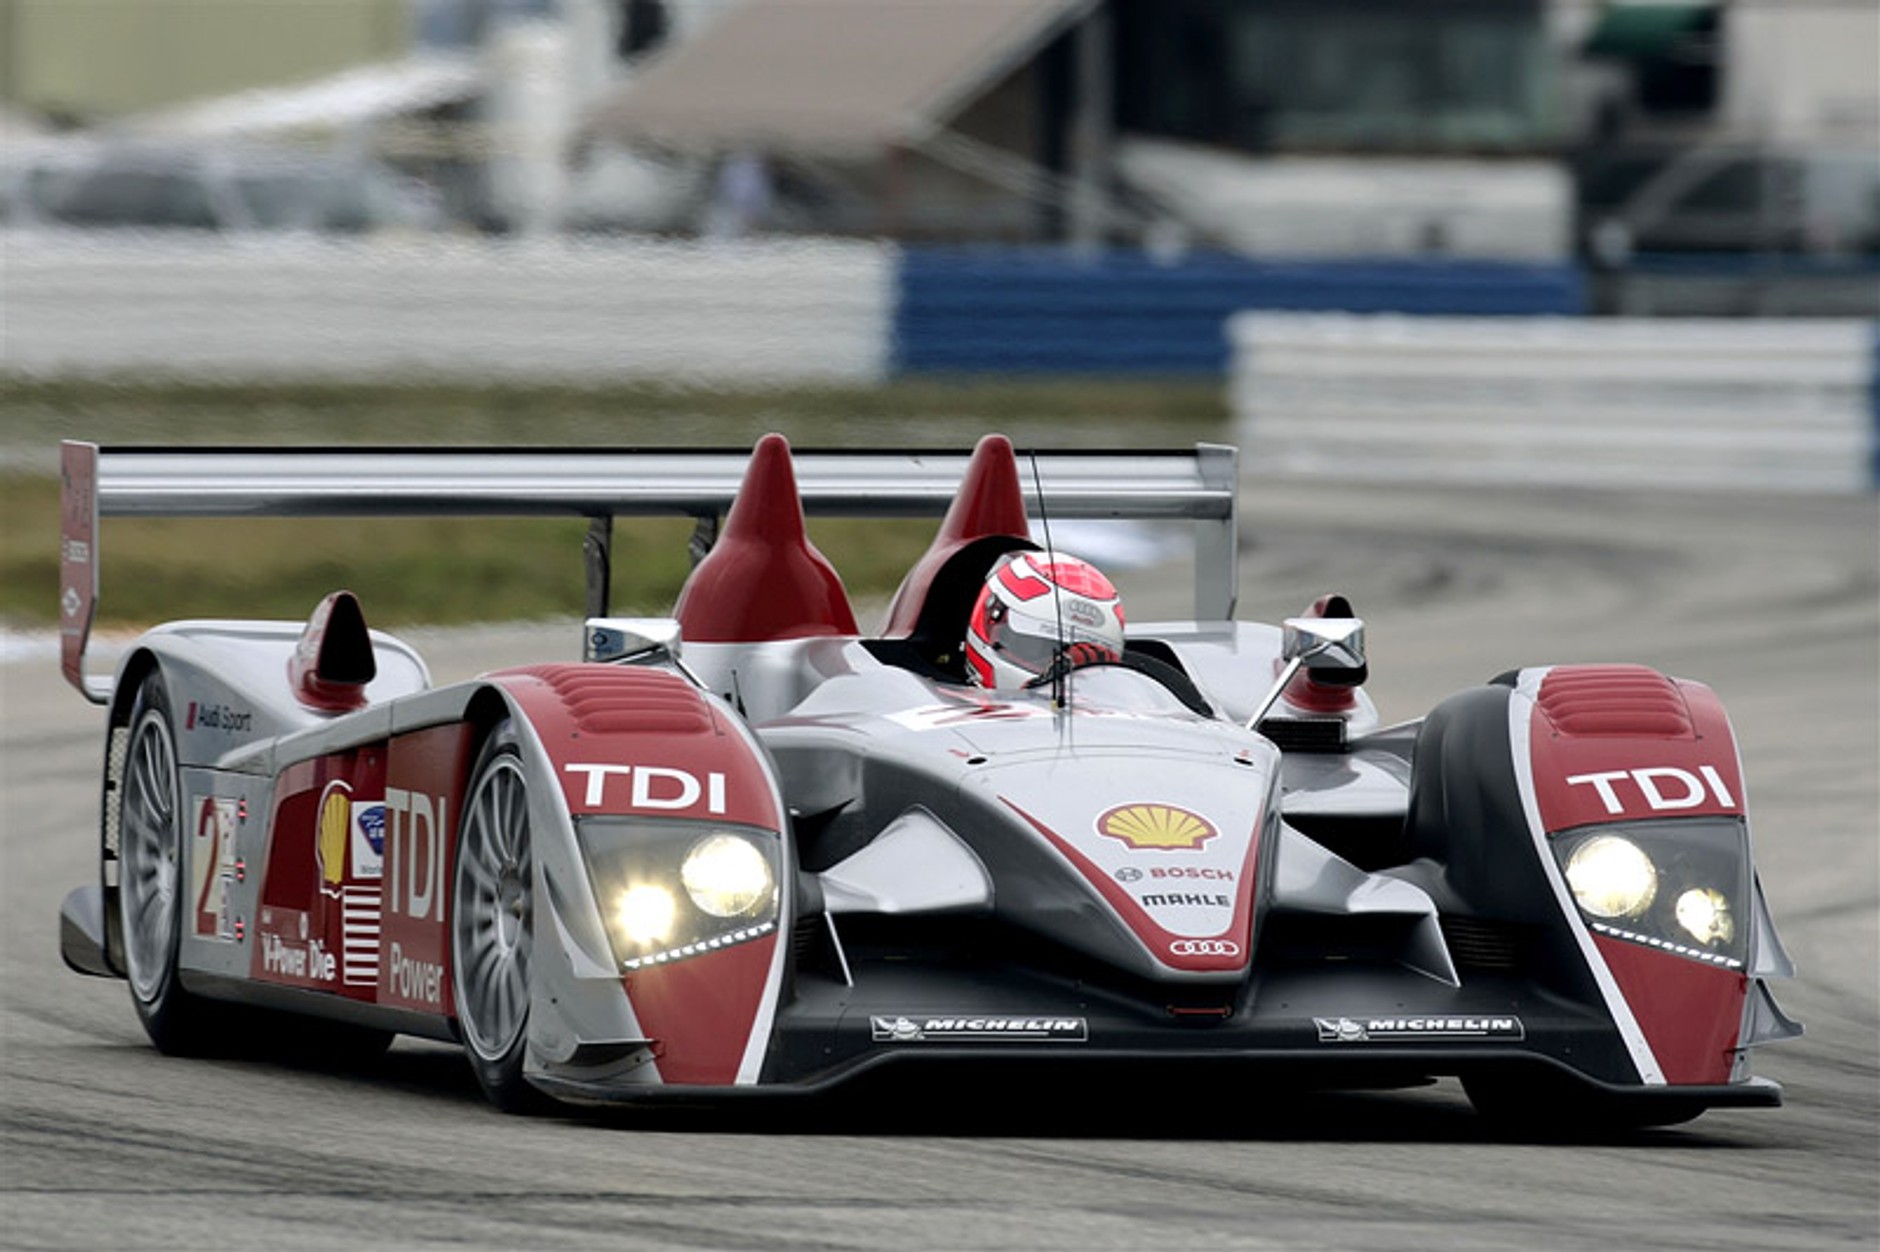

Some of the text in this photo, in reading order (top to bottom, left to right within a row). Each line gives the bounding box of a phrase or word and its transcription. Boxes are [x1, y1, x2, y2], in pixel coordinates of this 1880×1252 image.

[222, 705, 252, 736] Sport
[565, 753, 726, 814] TDI
[1566, 756, 1736, 814] TDI
[197, 797, 219, 936] 2
[385, 787, 446, 922] TDI
[1150, 867, 1234, 881] BOSCH
[1142, 894, 1231, 908] MAHLE
[390, 942, 444, 1003] Power
[924, 1019, 1079, 1031] MICHELIN
[1368, 1019, 1513, 1030] MICHELIN
